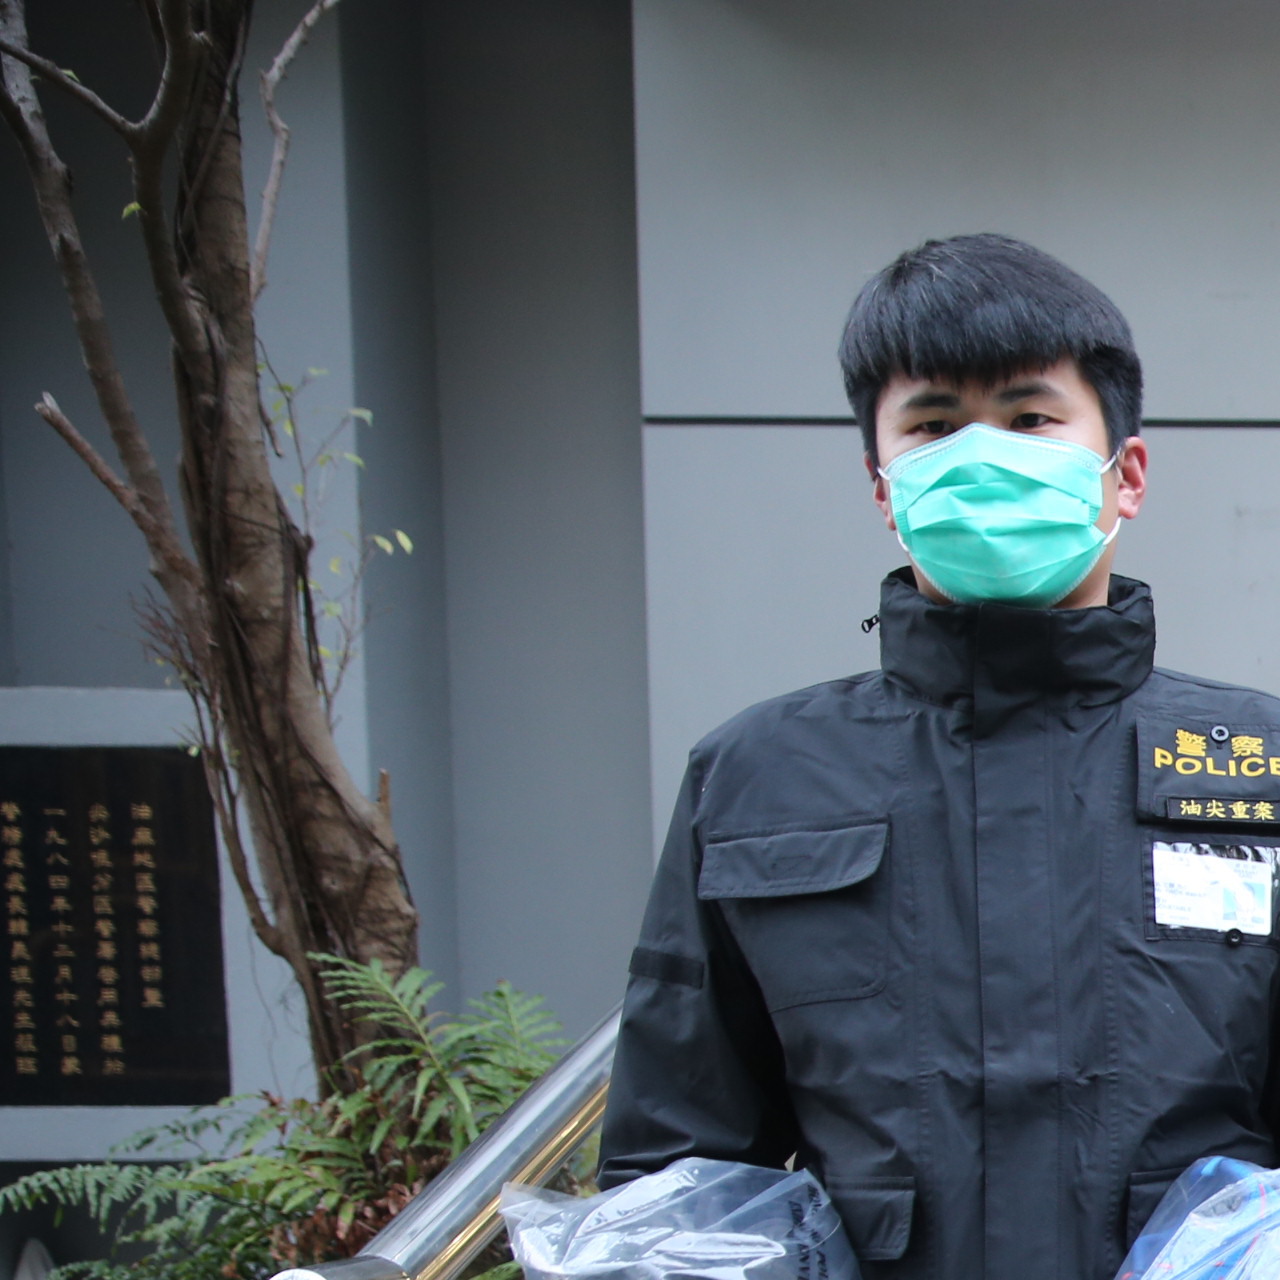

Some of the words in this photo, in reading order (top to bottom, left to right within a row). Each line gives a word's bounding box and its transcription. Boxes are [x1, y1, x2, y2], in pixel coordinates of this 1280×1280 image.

[1175, 728, 1264, 758] 警察
[1180, 800, 1275, 820] 油尖重案
